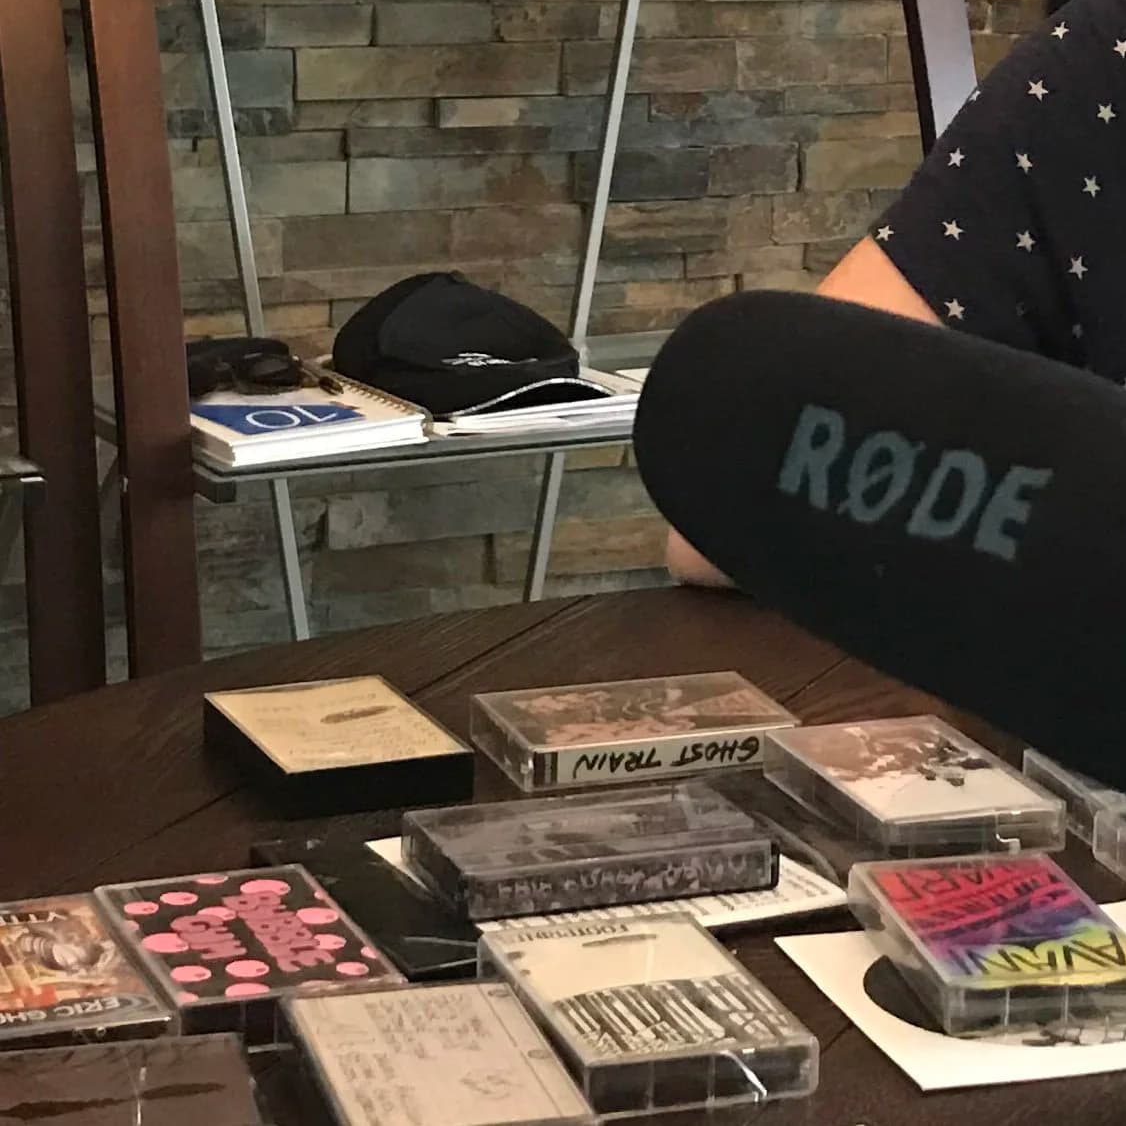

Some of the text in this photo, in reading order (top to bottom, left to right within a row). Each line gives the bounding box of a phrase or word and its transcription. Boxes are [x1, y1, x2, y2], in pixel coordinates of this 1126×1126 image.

[572, 735, 761, 780] GHOST TRAIN
[169, 913, 249, 961] GUM
[221, 890, 336, 973] BUBBLE
[53, 995, 121, 1017] ERIC
